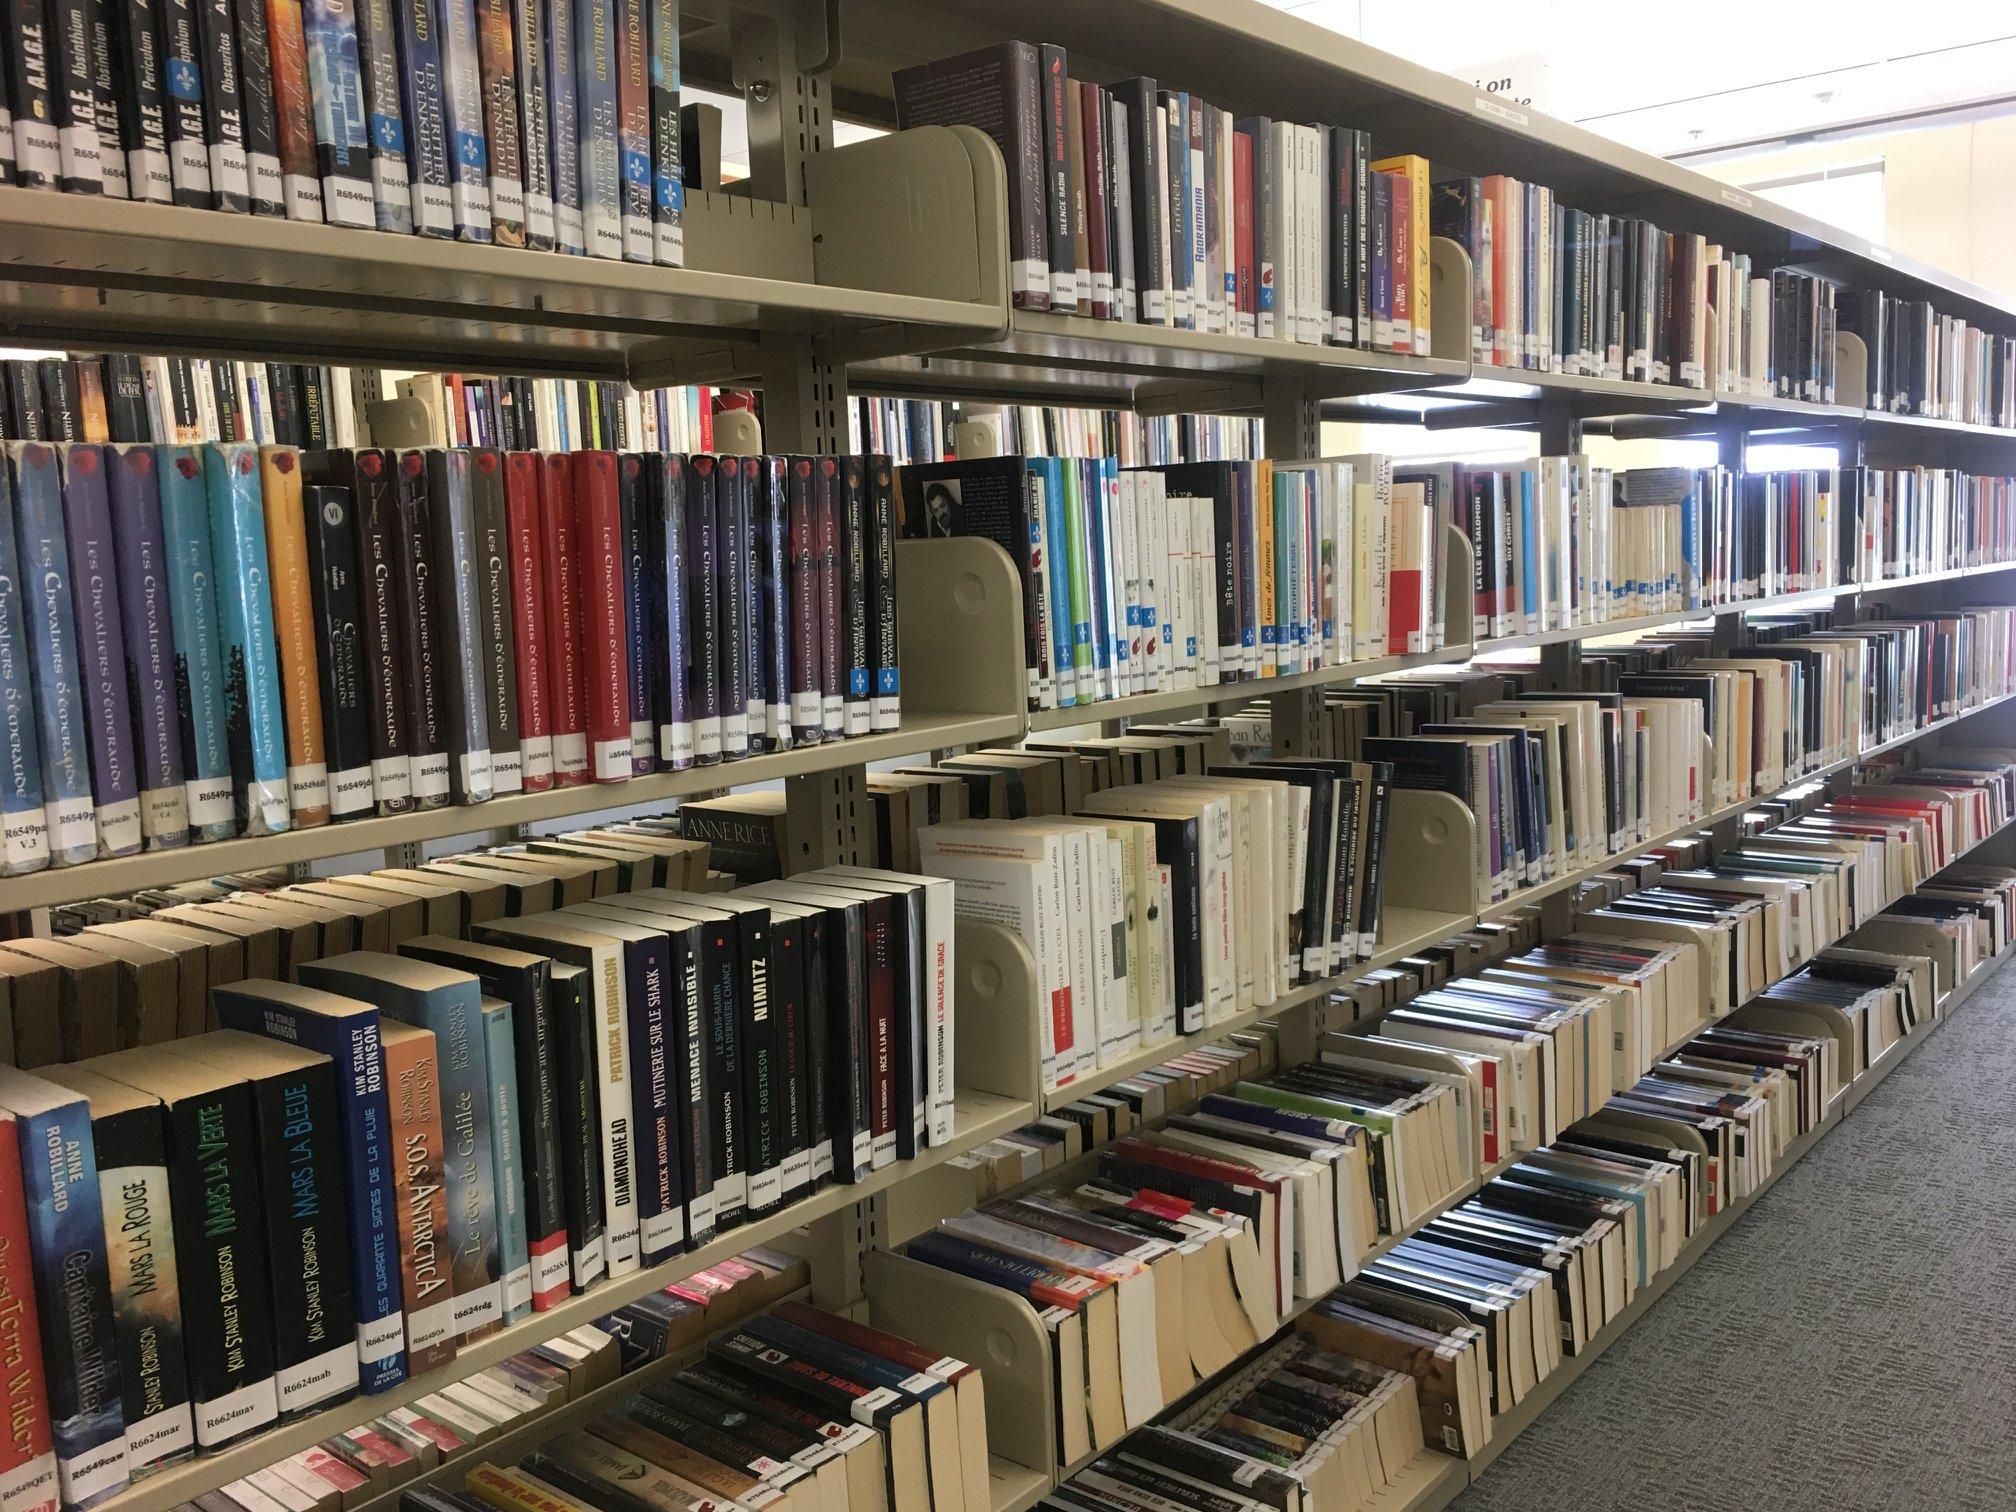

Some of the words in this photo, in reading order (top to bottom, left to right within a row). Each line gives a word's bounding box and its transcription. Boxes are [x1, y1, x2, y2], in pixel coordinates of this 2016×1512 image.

[69, 9, 88, 79] Absinthium
[94, 22, 112, 90] Absinthium
[139, 31, 156, 91] Periculum
[218, 33, 236, 94] Obscuritas
[1057, 200, 1068, 236] SILENCE
[1361, 262, 1367, 273] LA
[1225, 541, 1233, 575] noire
[1225, 579, 1233, 607] Bête
[687, 818, 734, 842] ANNE
[604, 956, 620, 1026] ROBINSON
[648, 967, 660, 1005] SHARK
[685, 963, 701, 1039] INVISIBLE
[751, 956, 769, 1024] NIMITZ
[650, 1005, 660, 1021] LE
[651, 1019, 663, 1043] SUR
[352, 1029, 365, 1073] STANLEY
[364, 1025, 381, 1093] ROBINSON
[609, 1027, 624, 1084] PATRICK
[690, 1040, 703, 1104] MENACE
[356, 1078, 366, 1096] KIM
[400, 1070, 415, 1126] ROBINSON
[651, 1042, 668, 1109] MUTINERIE
[758, 1048, 770, 1116] ROBINSON
[283, 1083, 309, 1139] BLEUE
[364, 1107, 376, 1142] PLUIE
[416, 1078, 433, 1124] STANLEY
[455, 1090, 477, 1158] Galilée
[724, 1091, 733, 1141] ROBINSON
[66, 1138, 84, 1183] ANNE
[367, 1145, 378, 1163] LA
[611, 1117, 630, 1209] DIAMONDHEAD
[655, 1115, 668, 1164] ROBINSON
[46, 1124, 68, 1213] ROBILLARD
[369, 1165, 379, 1182] DE
[461, 1160, 477, 1187] de
[658, 1164, 671, 1213] PATRICK
[121, 1178, 147, 1232] ROUGE
[370, 1187, 381, 1230] SIGNES
[300, 1226, 319, 1274] ROBINSON
[373, 1233, 387, 1294] QUARANTE
[409, 1183, 447, 1300] ANTARCTICA
[220, 1244, 240, 1303] ROBINSON
[305, 1274, 324, 1321] STANLEY
[223, 1299, 245, 1347] STANLEY
[308, 1319, 325, 1344] KIM
[139, 1326, 157, 1370] ROBINSON
[227, 1345, 246, 1373] KIM
[283, 1369, 332, 1396] R6624mab
[130, 1422, 181, 1451] R6624mar
[206, 1402, 256, 1430] R6624mav
